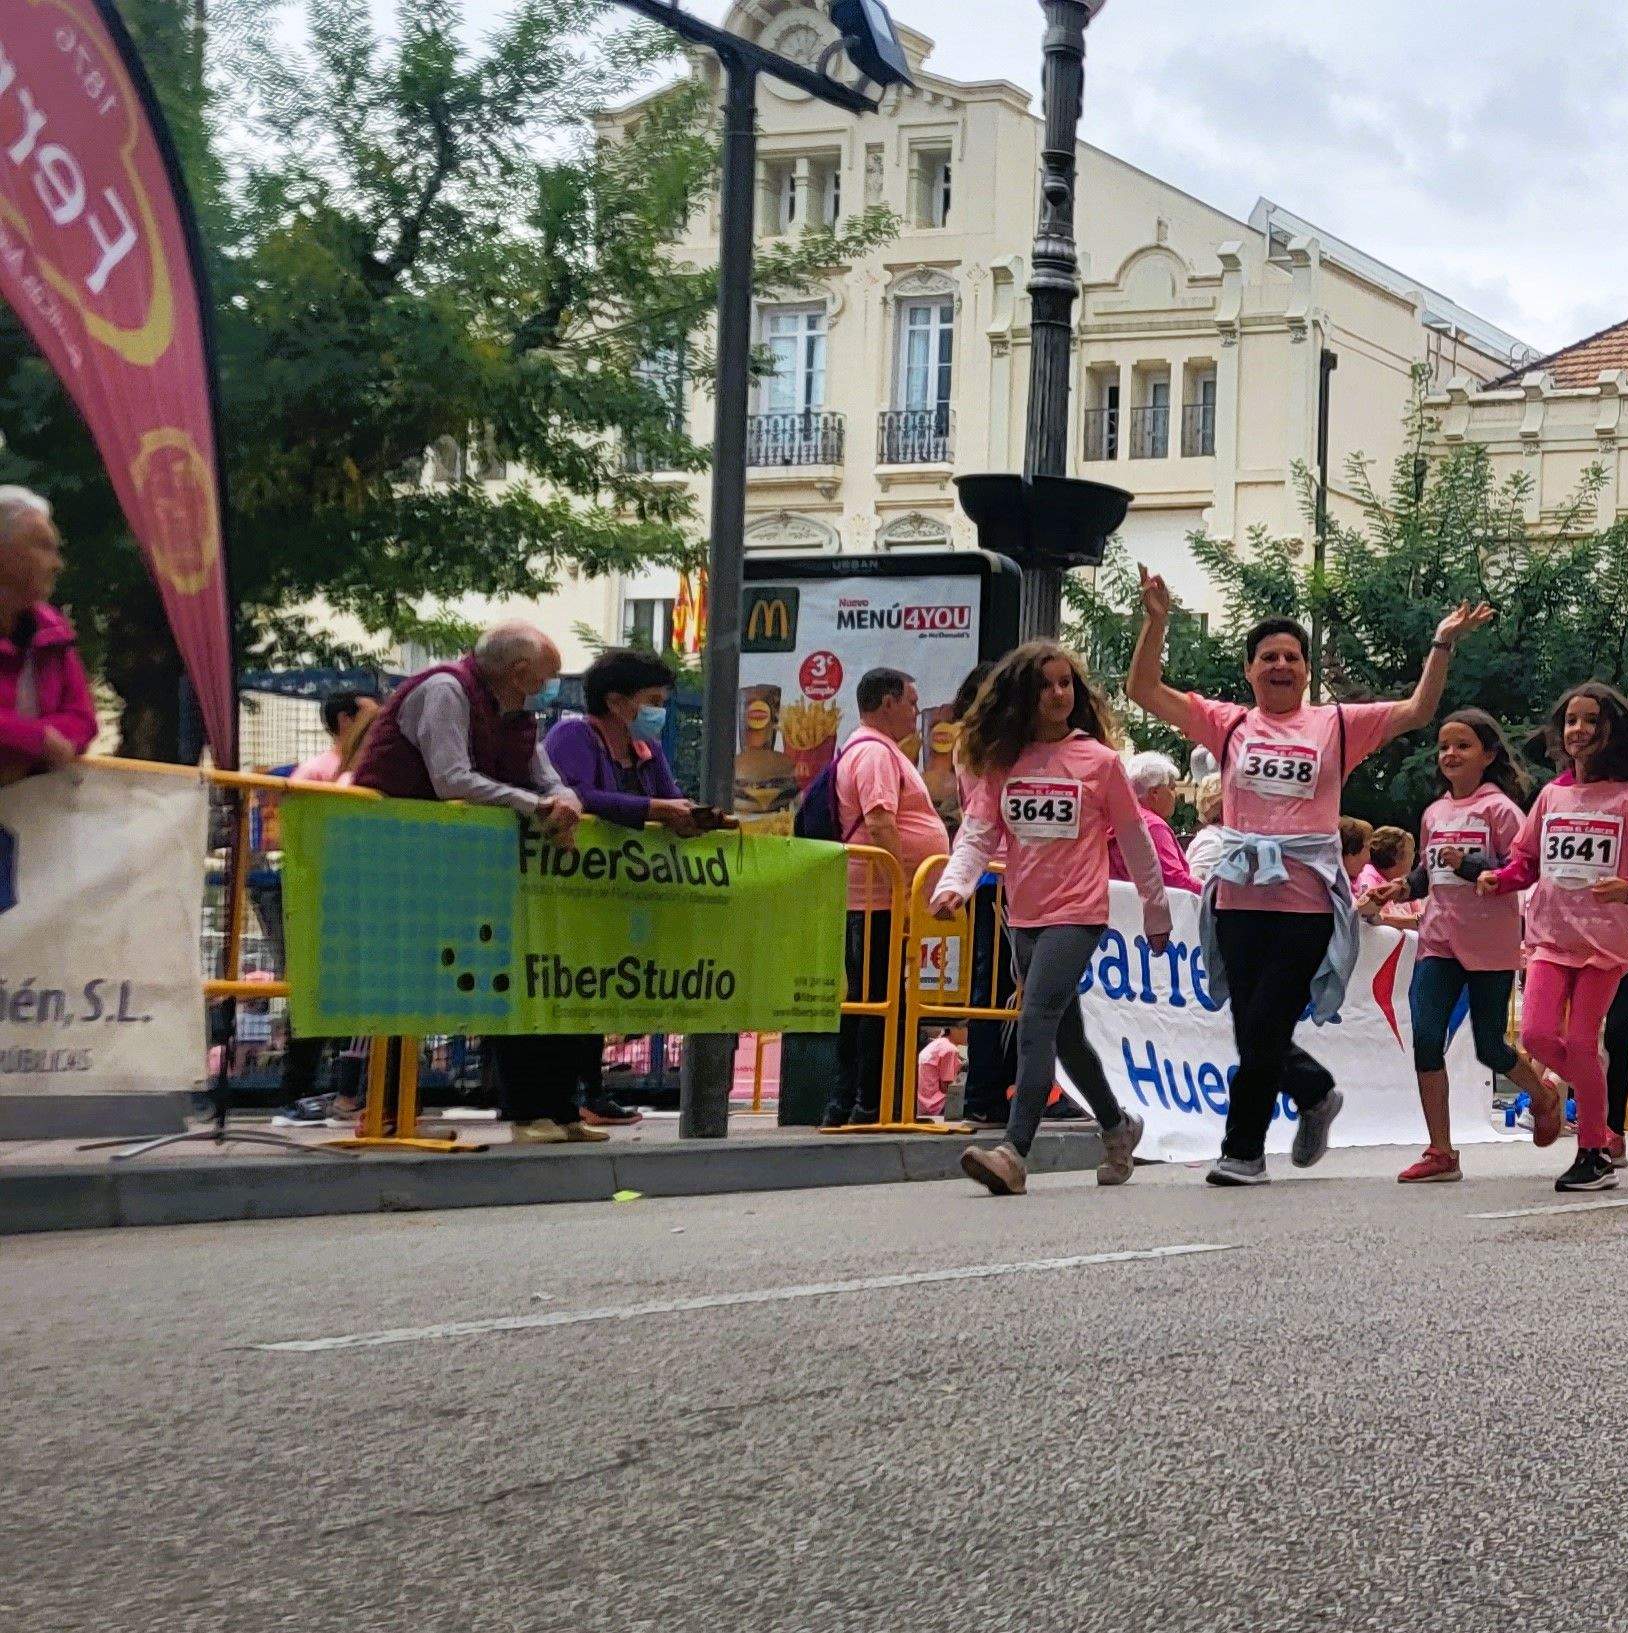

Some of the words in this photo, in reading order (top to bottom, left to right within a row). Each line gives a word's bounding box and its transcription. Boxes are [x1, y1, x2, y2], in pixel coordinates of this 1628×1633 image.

[836, 602, 902, 630] MENÚ
[905, 607, 969, 629] 4YOU
[838, 598, 870, 608] Nuevo
[1244, 756, 1314, 783] 3638
[1008, 799, 1074, 822] 3643
[519, 829, 730, 887] FiberSalud
[1546, 836, 1612, 864] 3641
[525, 953, 736, 1002] FiberStudio
[80, 977, 153, 1023] S.L.
